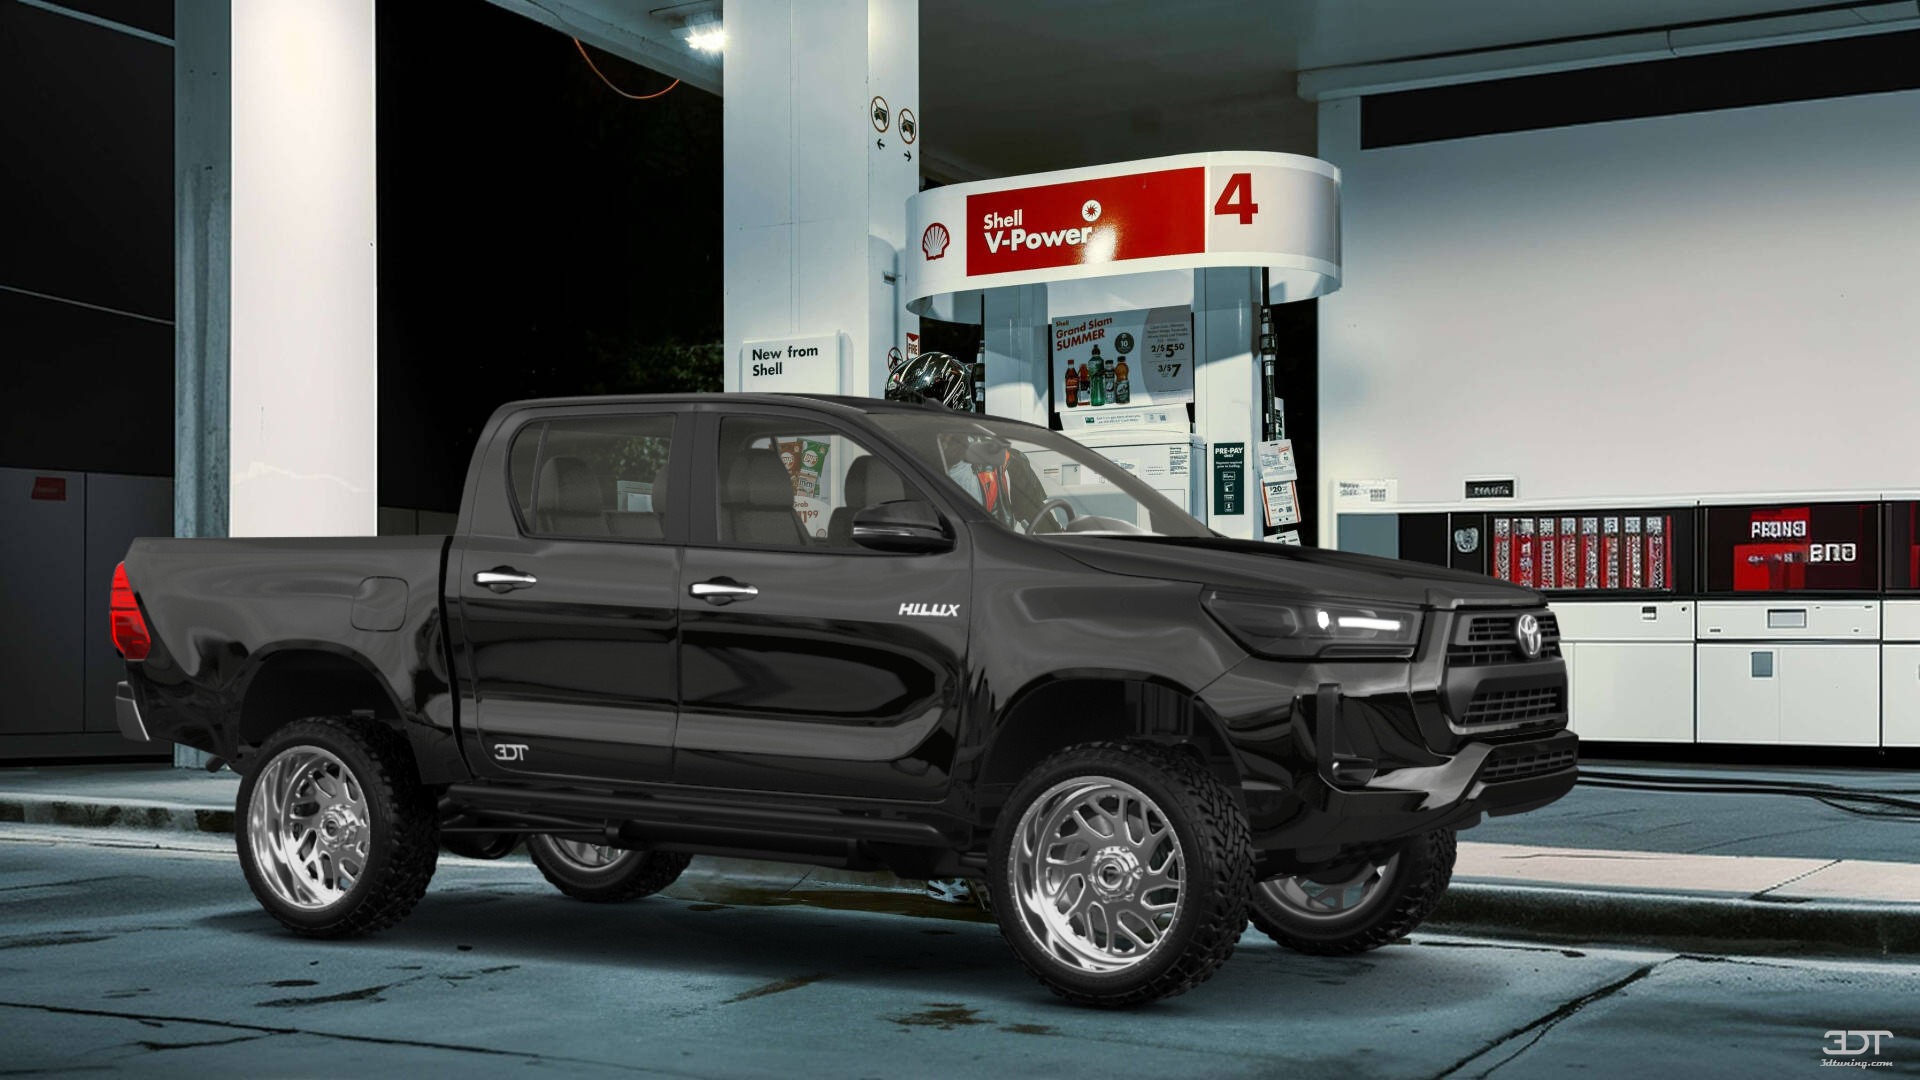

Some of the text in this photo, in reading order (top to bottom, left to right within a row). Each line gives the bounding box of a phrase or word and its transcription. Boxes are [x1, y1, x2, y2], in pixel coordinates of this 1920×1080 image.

[1214, 172, 1259, 225] 4
[983, 209, 1023, 230] Shell
[984, 225, 1093, 254] V-Power
[1056, 317, 1113, 340] Grand Slam
[908, 343, 918, 355] FIRE
[1056, 329, 1105, 351] SUMMER
[752, 345, 819, 361] New from
[752, 362, 783, 377] Shell
[1215, 447, 1243, 455] PRE-PAY
[898, 603, 961, 617] HILUX
[494, 743, 530, 761] 3DT
